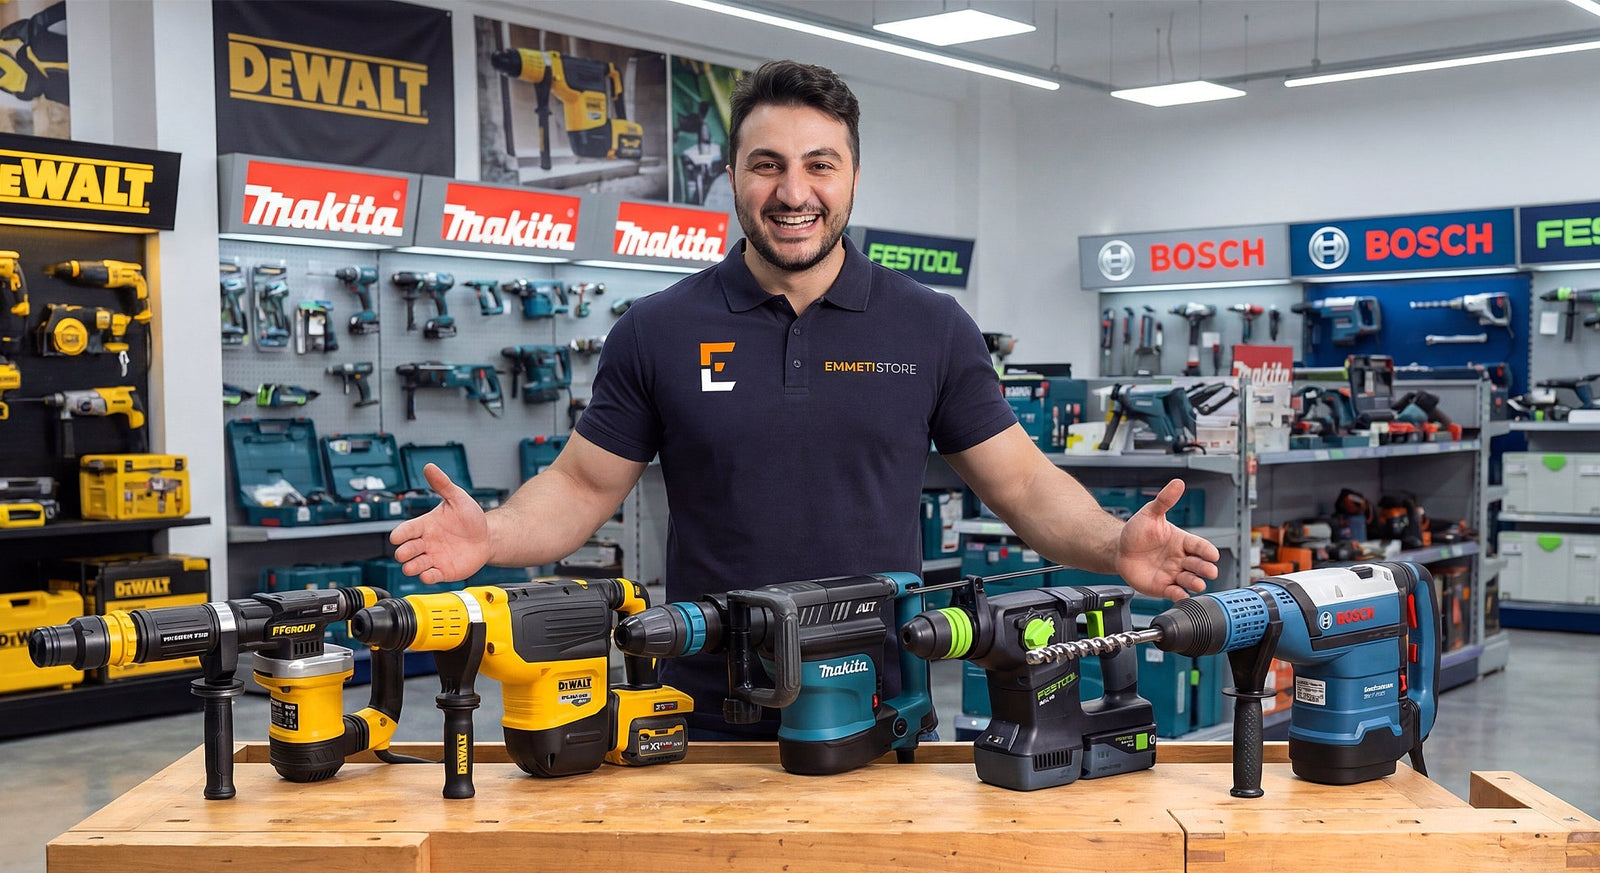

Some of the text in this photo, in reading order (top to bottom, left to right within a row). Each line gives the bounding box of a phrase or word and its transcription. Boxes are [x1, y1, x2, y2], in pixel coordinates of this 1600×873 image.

[1150, 238, 1266, 273] BOSCH
[1365, 222, 1493, 261] BOSCH
[868, 243, 963, 275] FESTOOL
[824, 361, 917, 376] EMMETISTORE
[272, 623, 316, 637] FFGROUP
